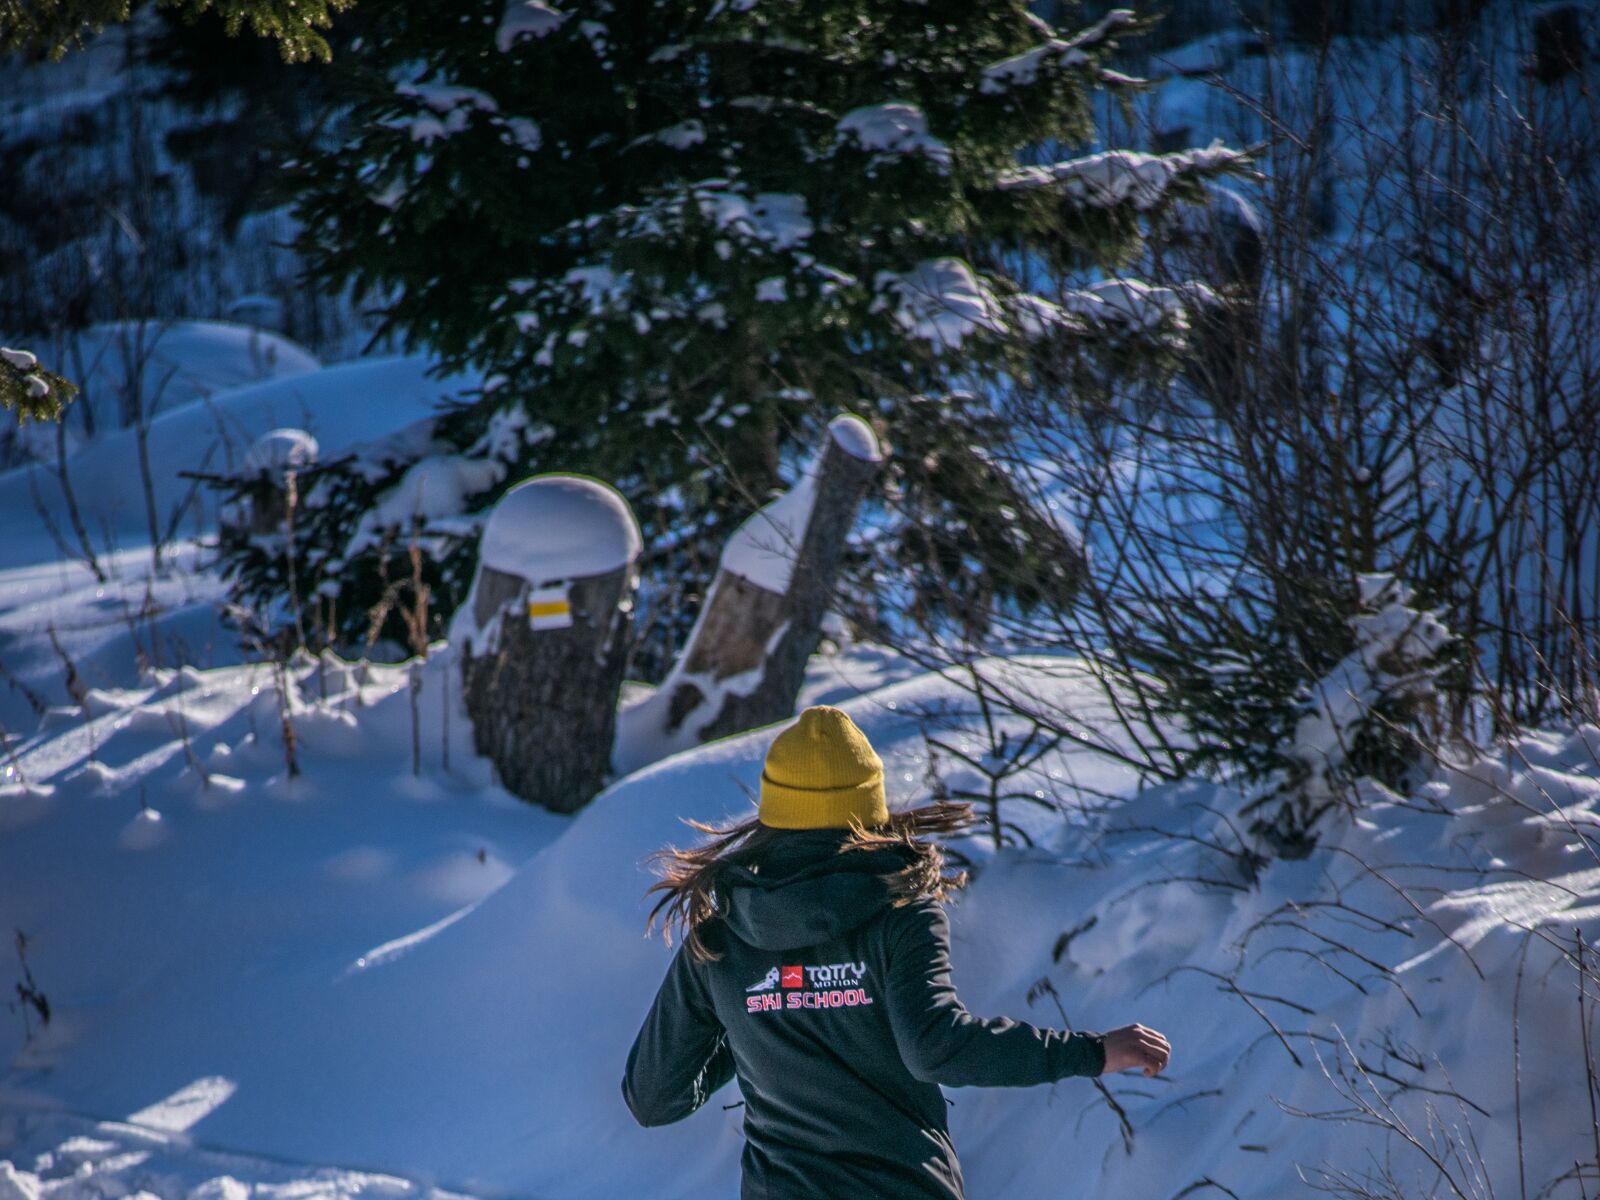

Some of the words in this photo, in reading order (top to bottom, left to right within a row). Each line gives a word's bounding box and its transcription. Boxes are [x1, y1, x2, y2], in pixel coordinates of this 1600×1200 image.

[813, 979, 859, 988] MOTION
[746, 992, 782, 1013] SKI
[786, 988, 873, 1009] SCHOOL
